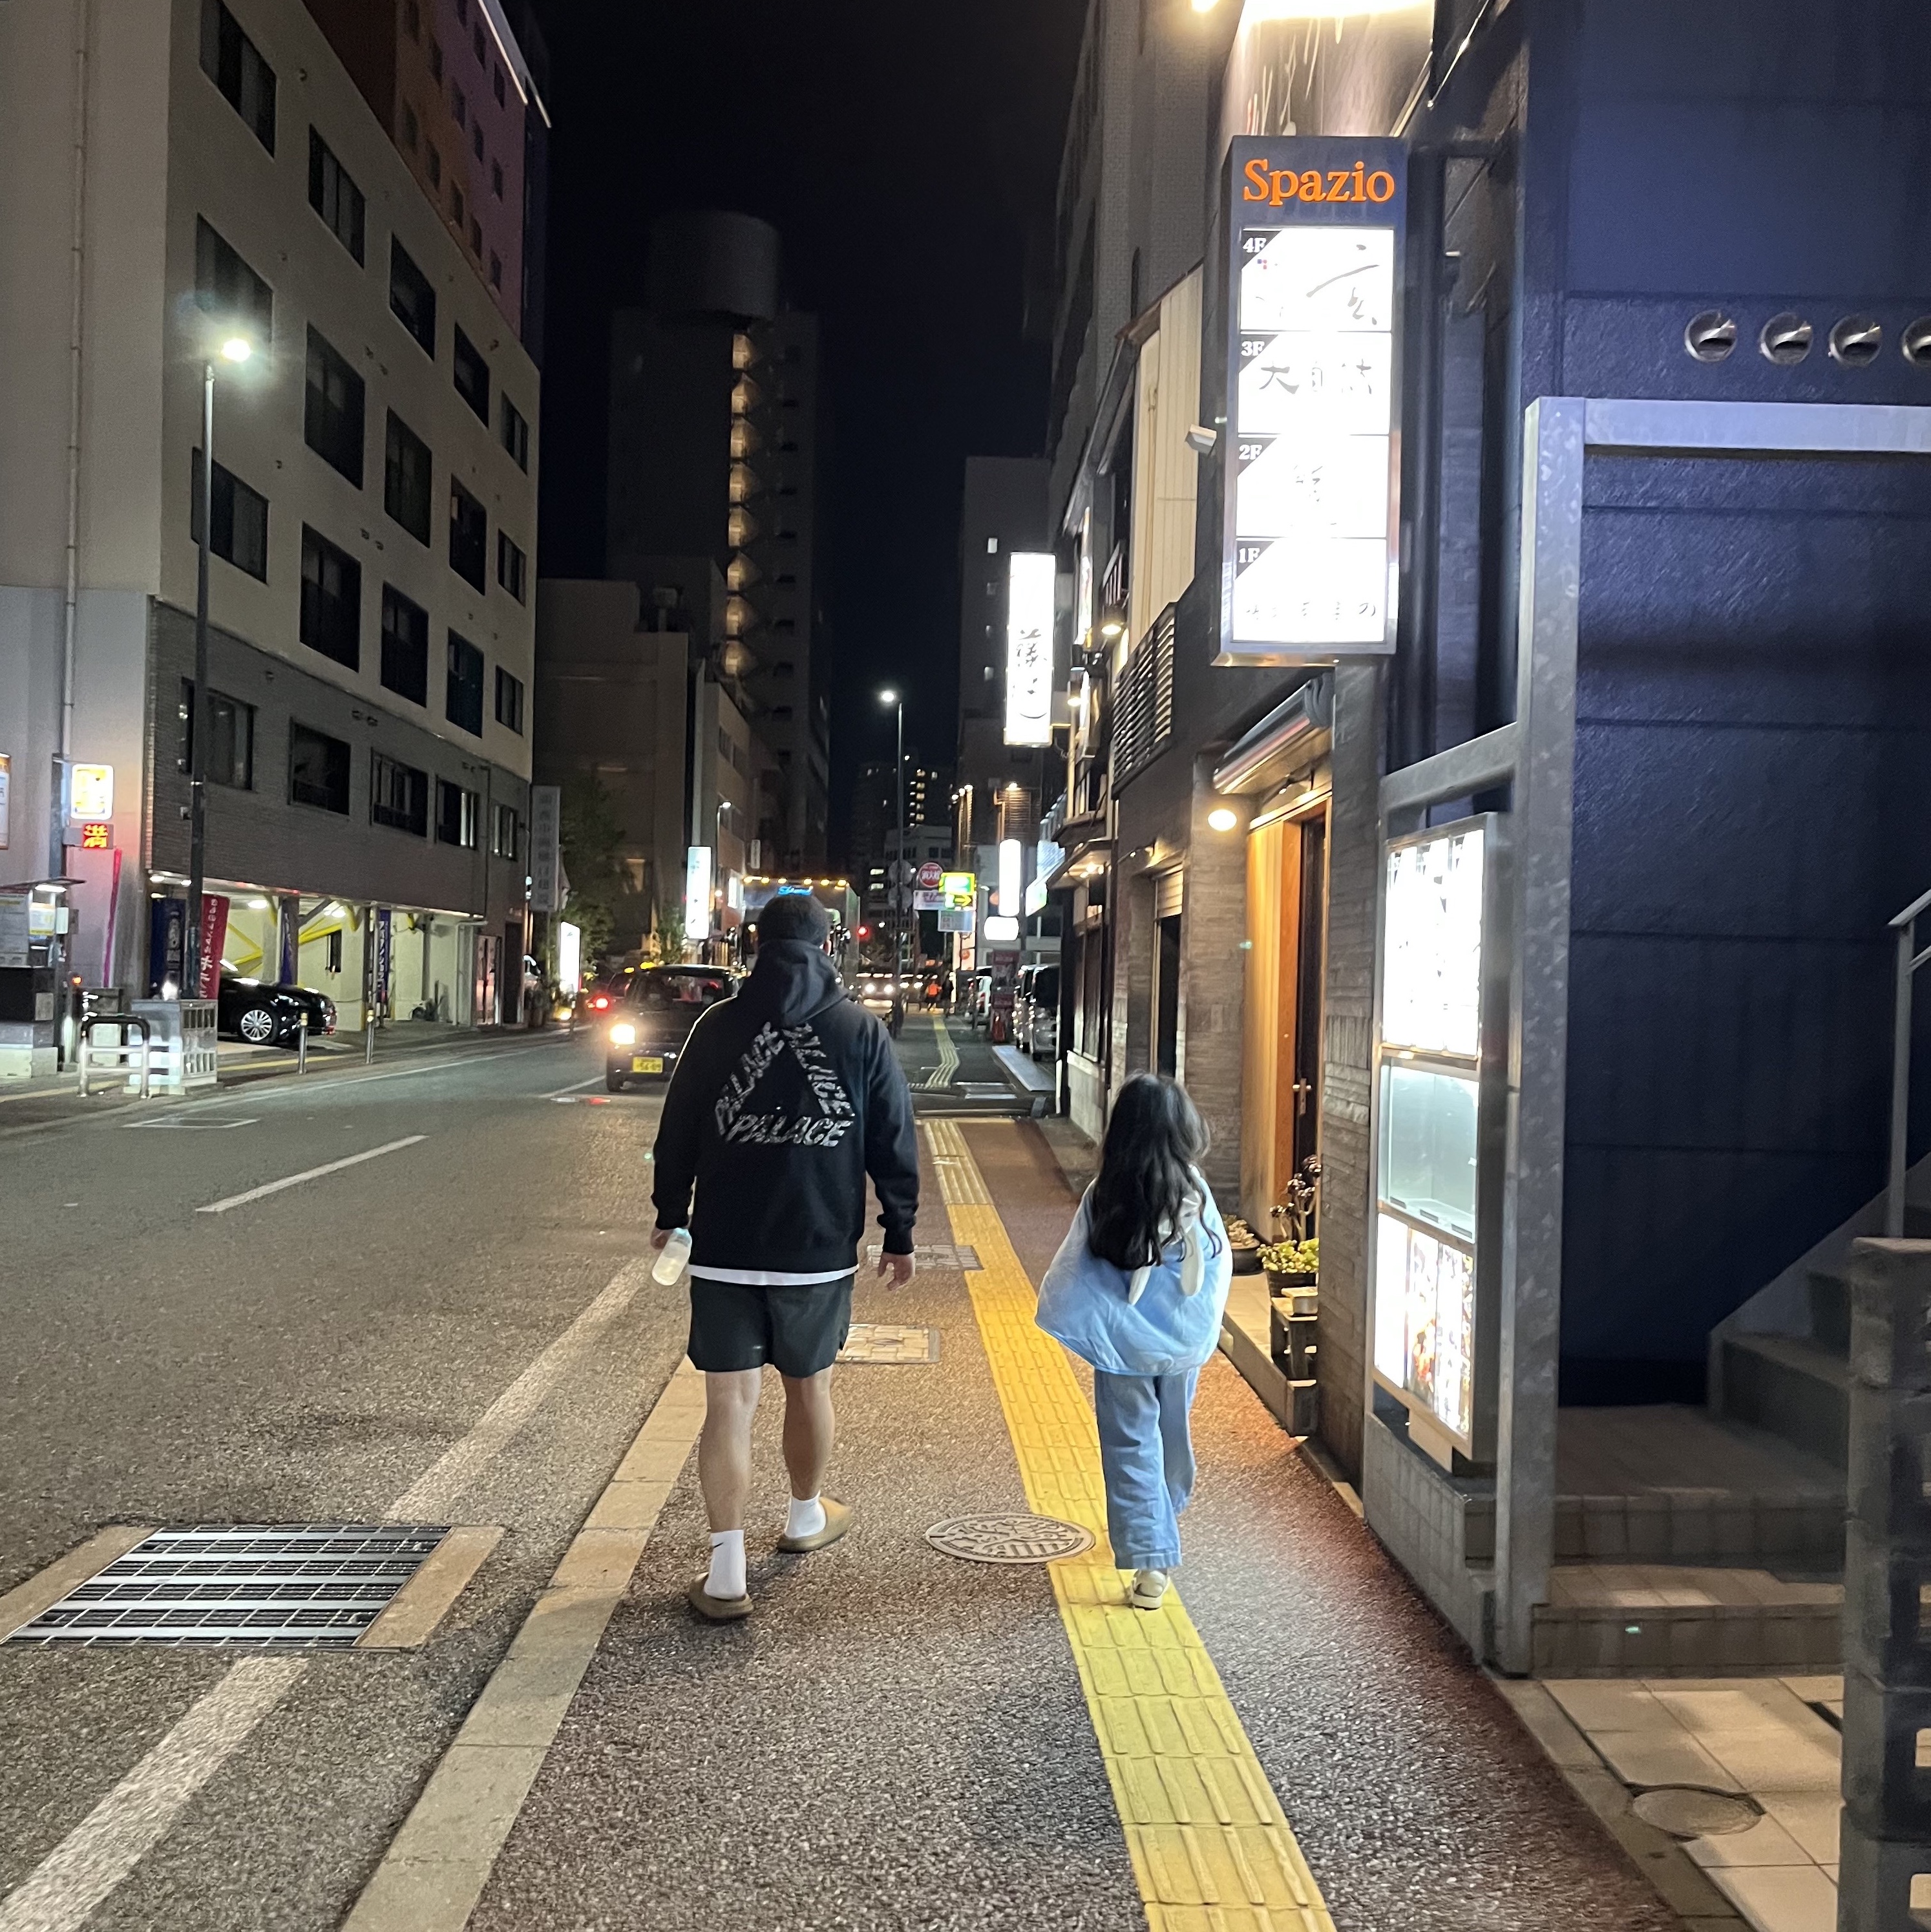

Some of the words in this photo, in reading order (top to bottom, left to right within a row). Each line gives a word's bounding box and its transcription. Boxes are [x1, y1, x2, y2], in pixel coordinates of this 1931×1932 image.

[1243, 158, 1395, 206] Spazio
[1243, 237, 1267, 253] 4F
[1241, 341, 1265, 356] 3F
[1238, 444, 1263, 460] 2F
[1238, 547, 1261, 564] 1F
[726, 1114, 854, 1147] PALACE
